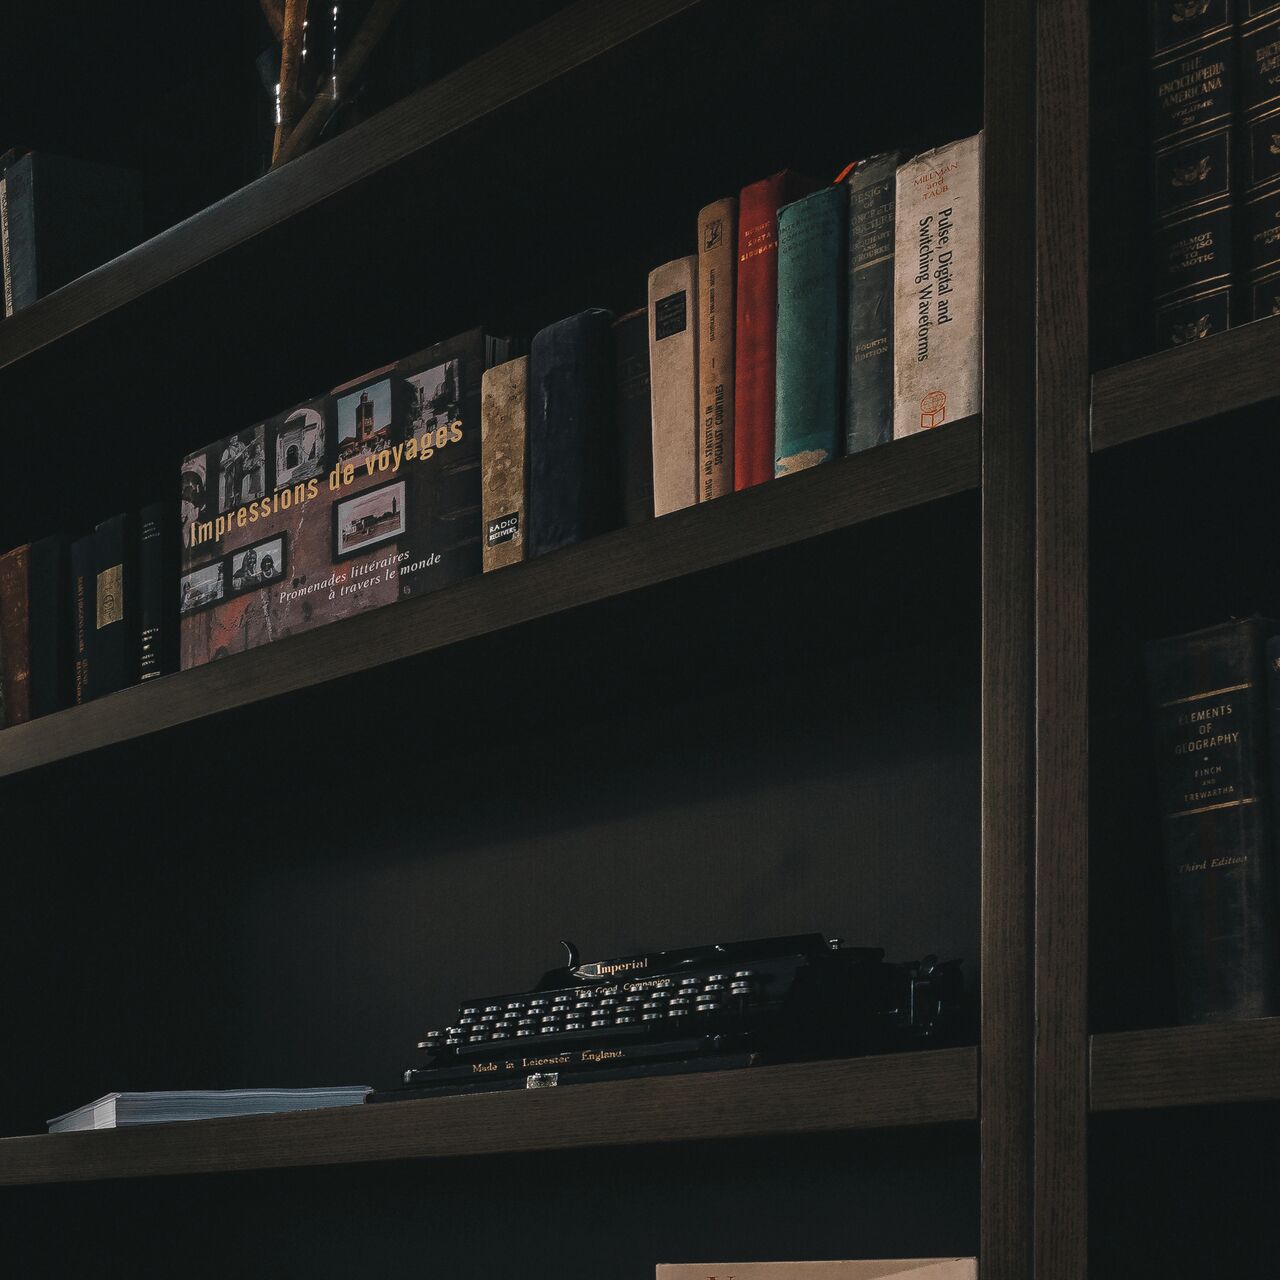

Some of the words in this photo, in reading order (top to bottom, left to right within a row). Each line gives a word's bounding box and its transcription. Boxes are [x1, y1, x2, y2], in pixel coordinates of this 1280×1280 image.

[912, 161, 958, 187] MILLMAN
[927, 177, 945, 191] and
[914, 216, 933, 285] Switching
[934, 251, 953, 296] Digital
[918, 284, 933, 363] Waveforms
[937, 298, 953, 325] and
[714, 384, 724, 425] COUNTRIES
[705, 416, 713, 457] STATISTICS
[714, 429, 724, 465] SOCIALIST
[705, 459, 713, 475] AND
[191, 478, 319, 547] Impressions
[329, 463, 354, 491] de
[366, 420, 464, 476] voyages
[490, 518, 518, 533] RADIO
[280, 573, 346, 603] Promenades
[350, 551, 410, 581] littéraires
[329, 589, 336, 601] à
[340, 574, 381, 597] travers
[385, 568, 396, 582] le
[400, 553, 442, 576] monde
[1178, 704, 1233, 726] ELEMENTS
[1199, 722, 1213, 735] OF
[1175, 731, 1240, 755] GEOGRAPHY
[1194, 766, 1222, 779] FINCH
[1178, 860, 1207, 874] Third
[1210, 855, 1248, 868] Edition
[596, 957, 648, 976] Imperial
[472, 1062, 498, 1073] Made
[505, 1060, 515, 1070] in
[522, 1055, 571, 1068] Leicester
